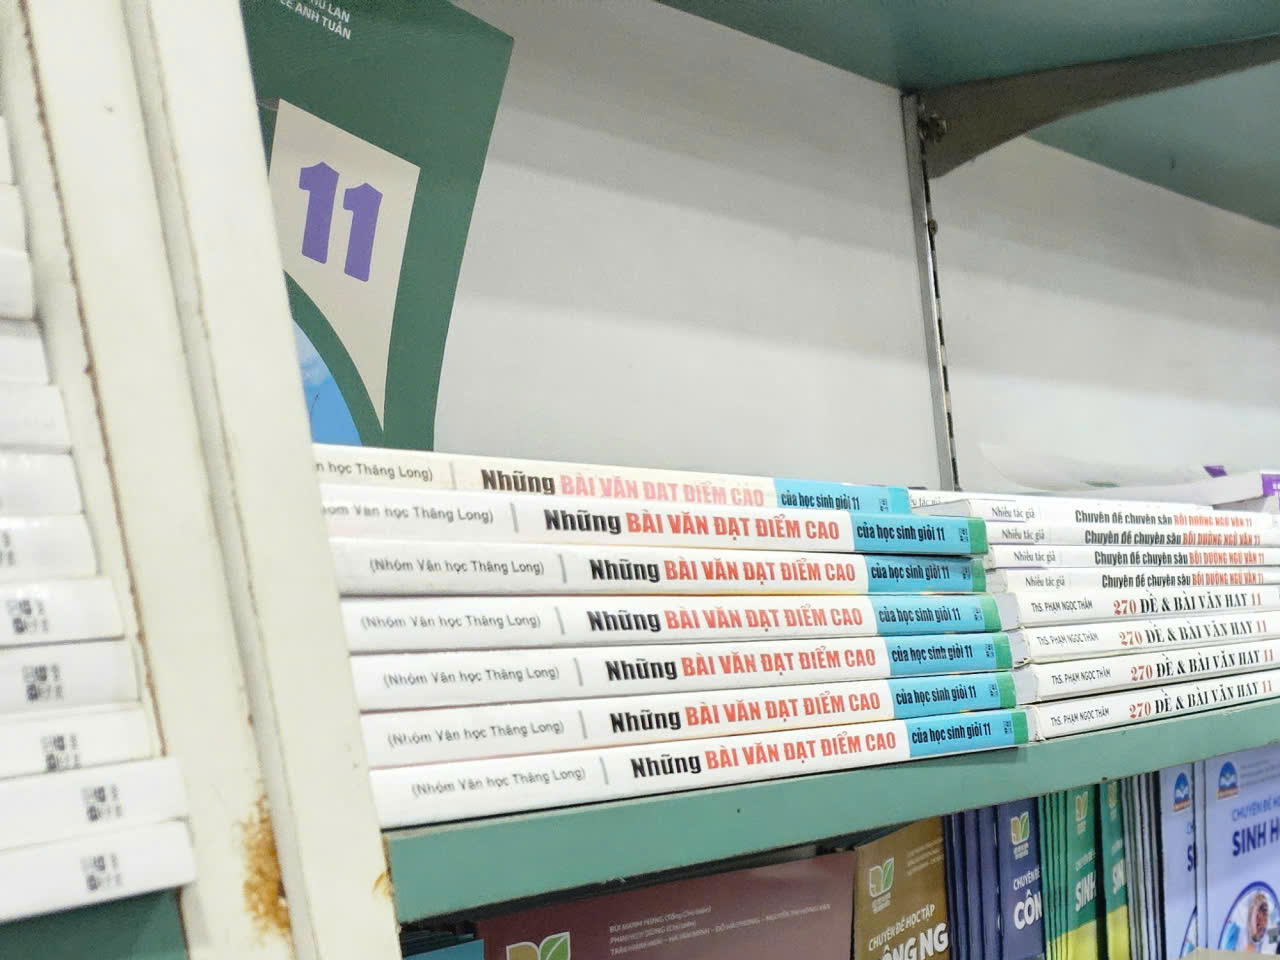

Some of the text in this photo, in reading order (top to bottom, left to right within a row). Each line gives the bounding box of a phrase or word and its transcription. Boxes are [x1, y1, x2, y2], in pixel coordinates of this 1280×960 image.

[294, 2, 320, 23] ANH
[321, 15, 352, 40] TUẤN
[327, 3, 351, 23] LAN
[298, 161, 384, 283] 11
[545, 508, 945, 543] Những BÀI VĂN ĐẠT ĐIỂM CAO của học sinh giỏi 11
[1085, 529, 1119, 545] Chuyên
[1121, 528, 1132, 545] đề
[1133, 531, 1164, 546] chuyên
[1166, 530, 1182, 545] sâu
[606, 644, 973, 682] Những BÀI VĂN ĐẠT ĐIỂM CAO của học sinh giỏi 11
[1130, 648, 1274, 682] 270 ĐỀ & BÀI VĂN HAY 11
[630, 723, 992, 778] Những BÀI VĂN ĐẠT ĐIỂM CAO của học sinh giỏi 11
[487, 775, 509, 792] học
[554, 768, 587, 786] Long)
[1231, 826, 1266, 857] SINH
[868, 903, 936, 952] CHUYÊN ĐỀ HỌC TẬP
[919, 922, 949, 960] NG
